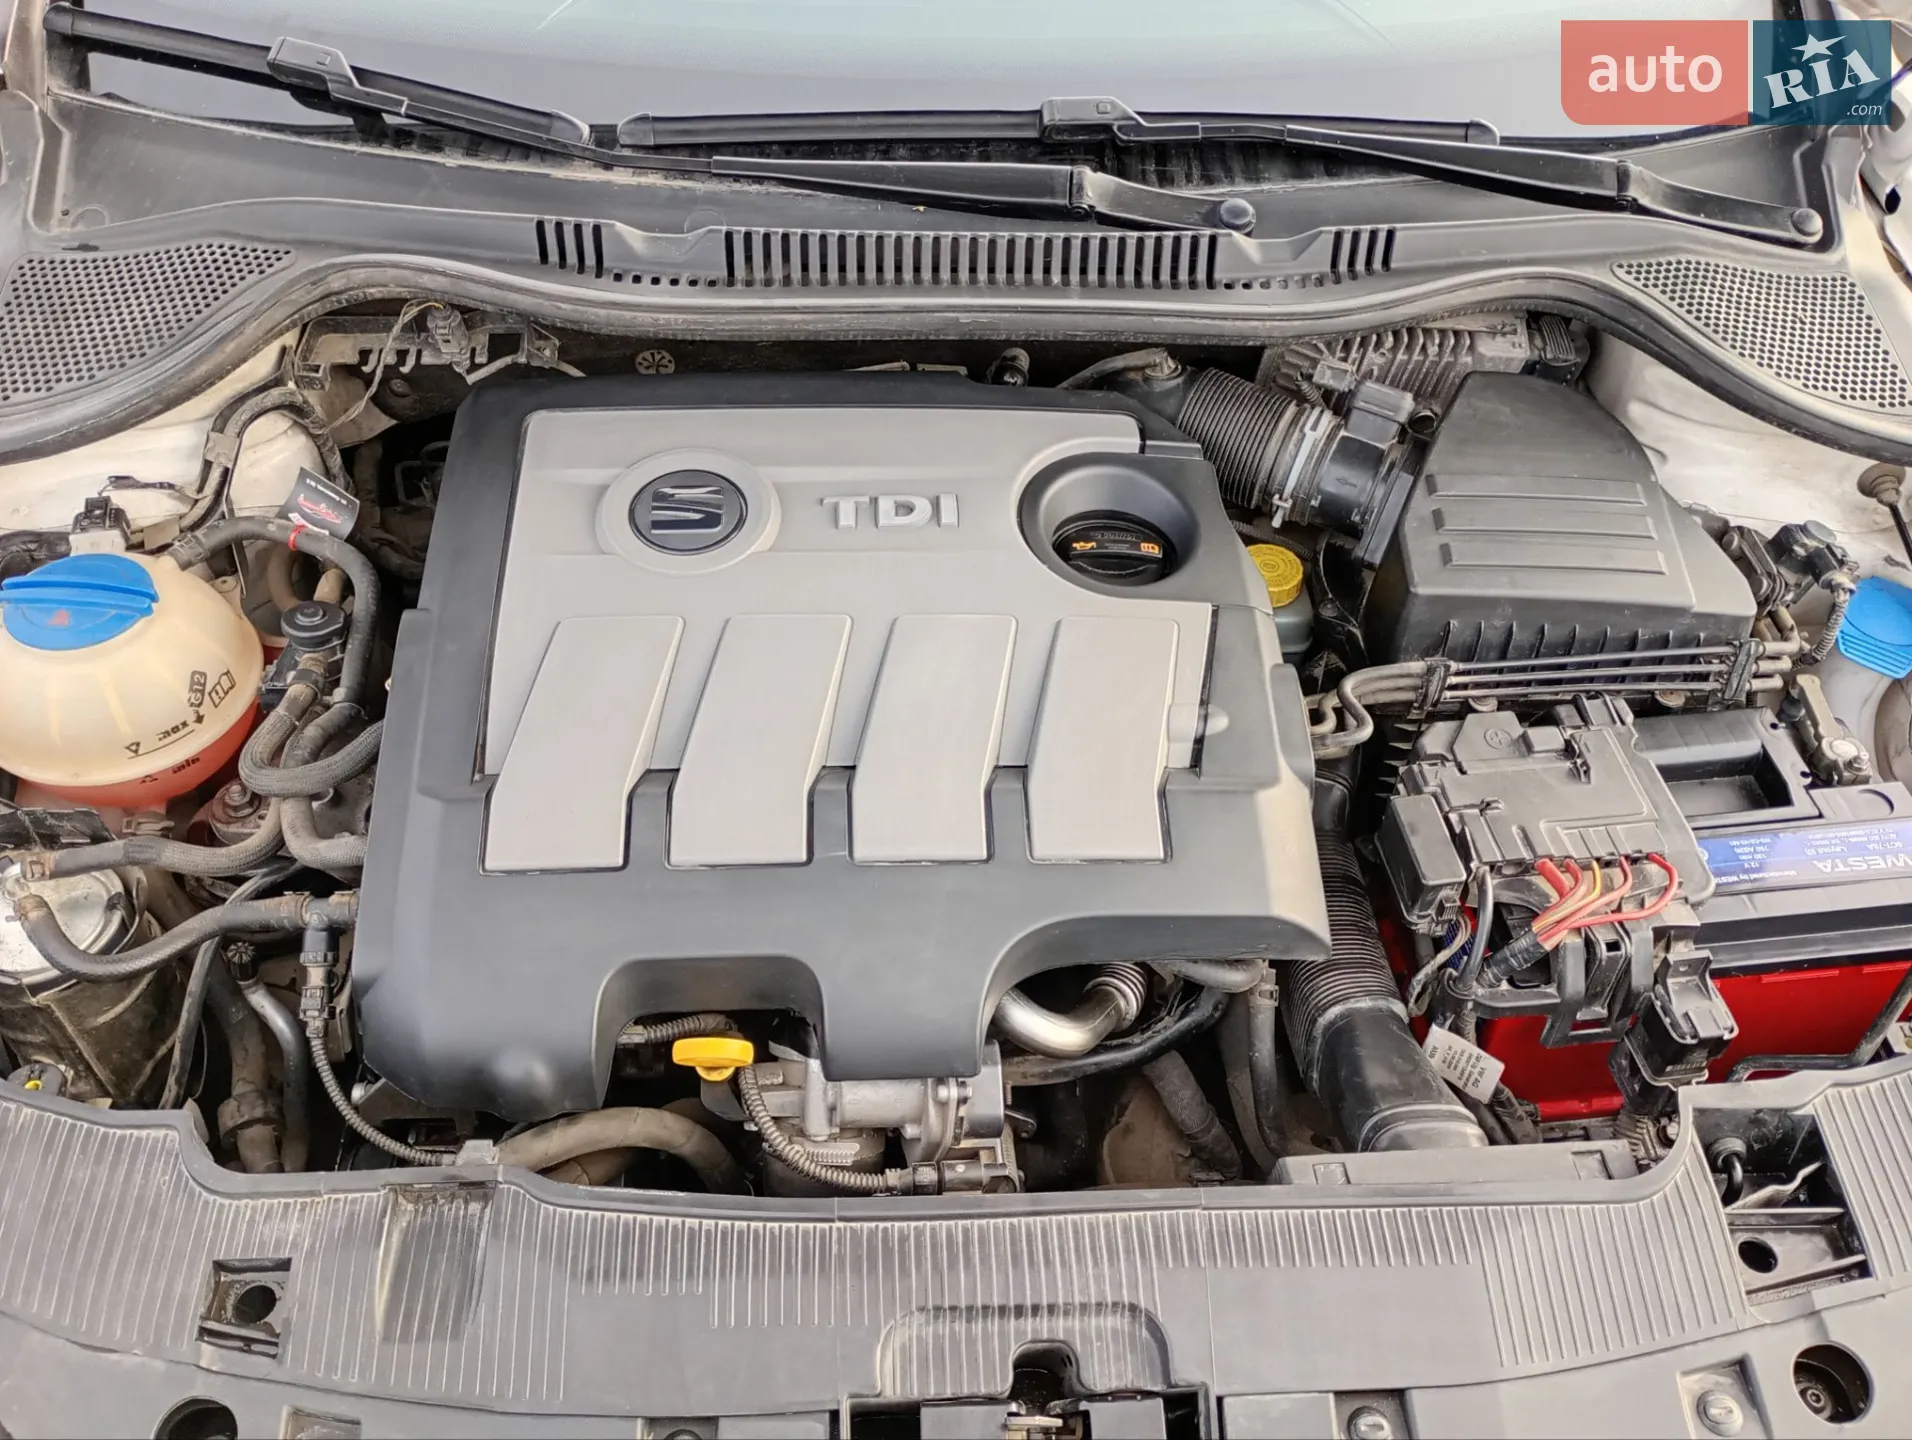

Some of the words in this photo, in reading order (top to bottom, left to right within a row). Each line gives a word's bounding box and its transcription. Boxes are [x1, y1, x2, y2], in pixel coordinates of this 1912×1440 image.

[819, 493, 960, 529] TDI
[191, 673, 205, 704] G12
[1811, 852, 1912, 874] WESTA
